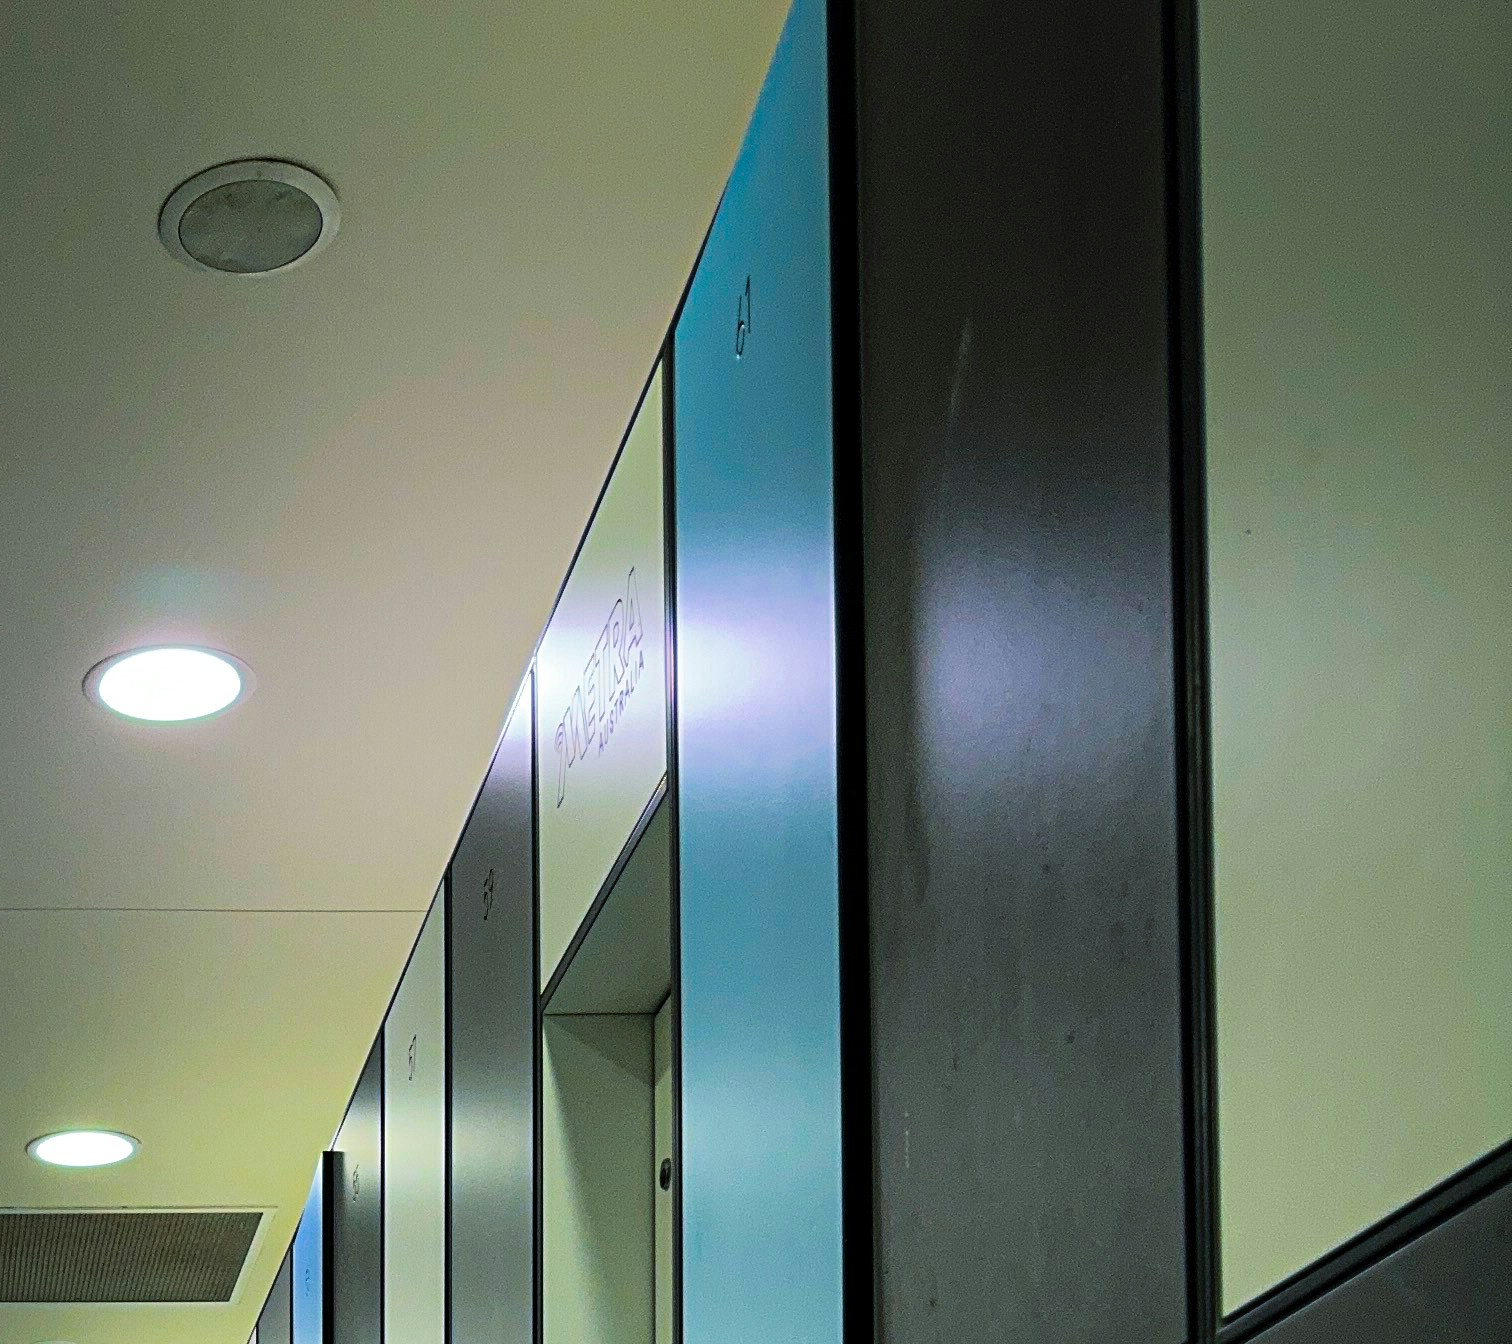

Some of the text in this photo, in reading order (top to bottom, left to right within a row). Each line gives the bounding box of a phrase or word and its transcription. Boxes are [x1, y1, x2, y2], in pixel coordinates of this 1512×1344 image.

[736, 274, 751, 356] 61
[554, 565, 644, 809] METRA
[598, 649, 645, 758] AUSTRALIA
[483, 868, 494, 921] 59
